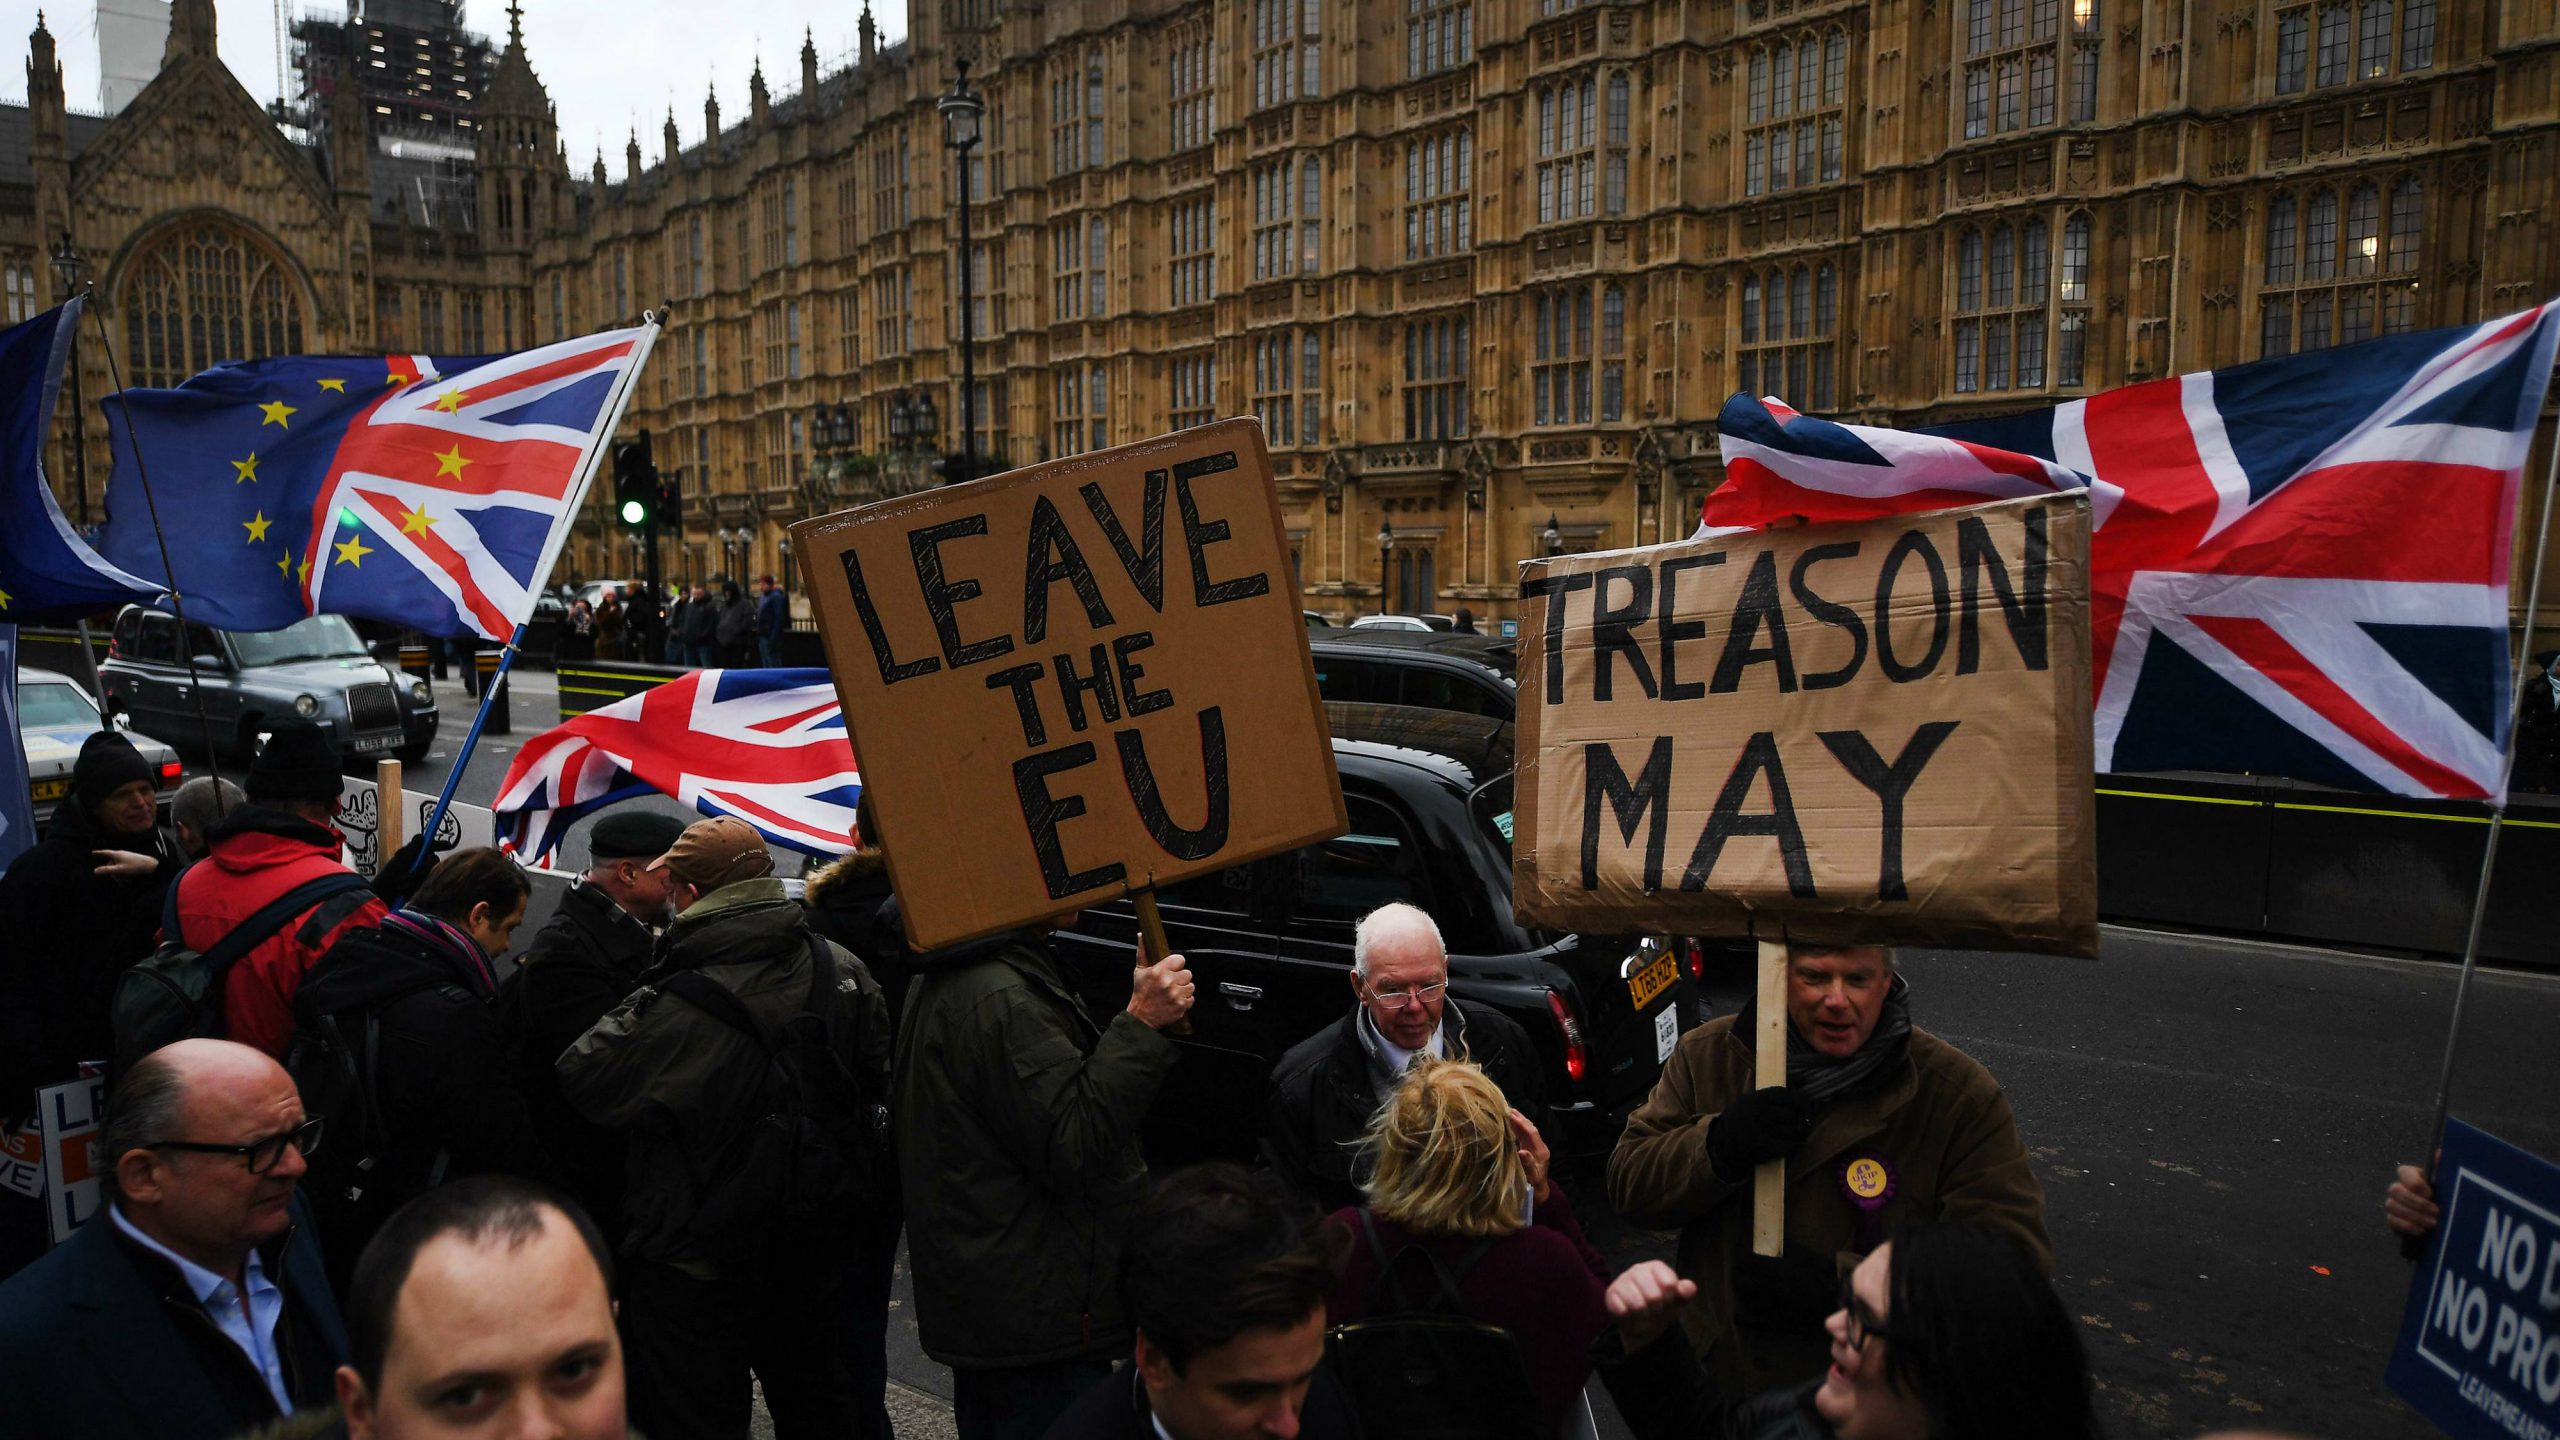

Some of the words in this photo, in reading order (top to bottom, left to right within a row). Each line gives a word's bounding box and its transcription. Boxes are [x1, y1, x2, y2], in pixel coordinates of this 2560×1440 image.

[840, 451, 1269, 686] LEAVE
[1520, 506, 2050, 705] TREASON
[986, 631, 1175, 748] THE
[1012, 706, 1231, 900] EU
[1581, 720, 1961, 902] MAY
[1632, 967, 1657, 1003] LT66
[2435, 1270, 2488, 1351] NO
[2478, 1206, 2537, 1292] NO
